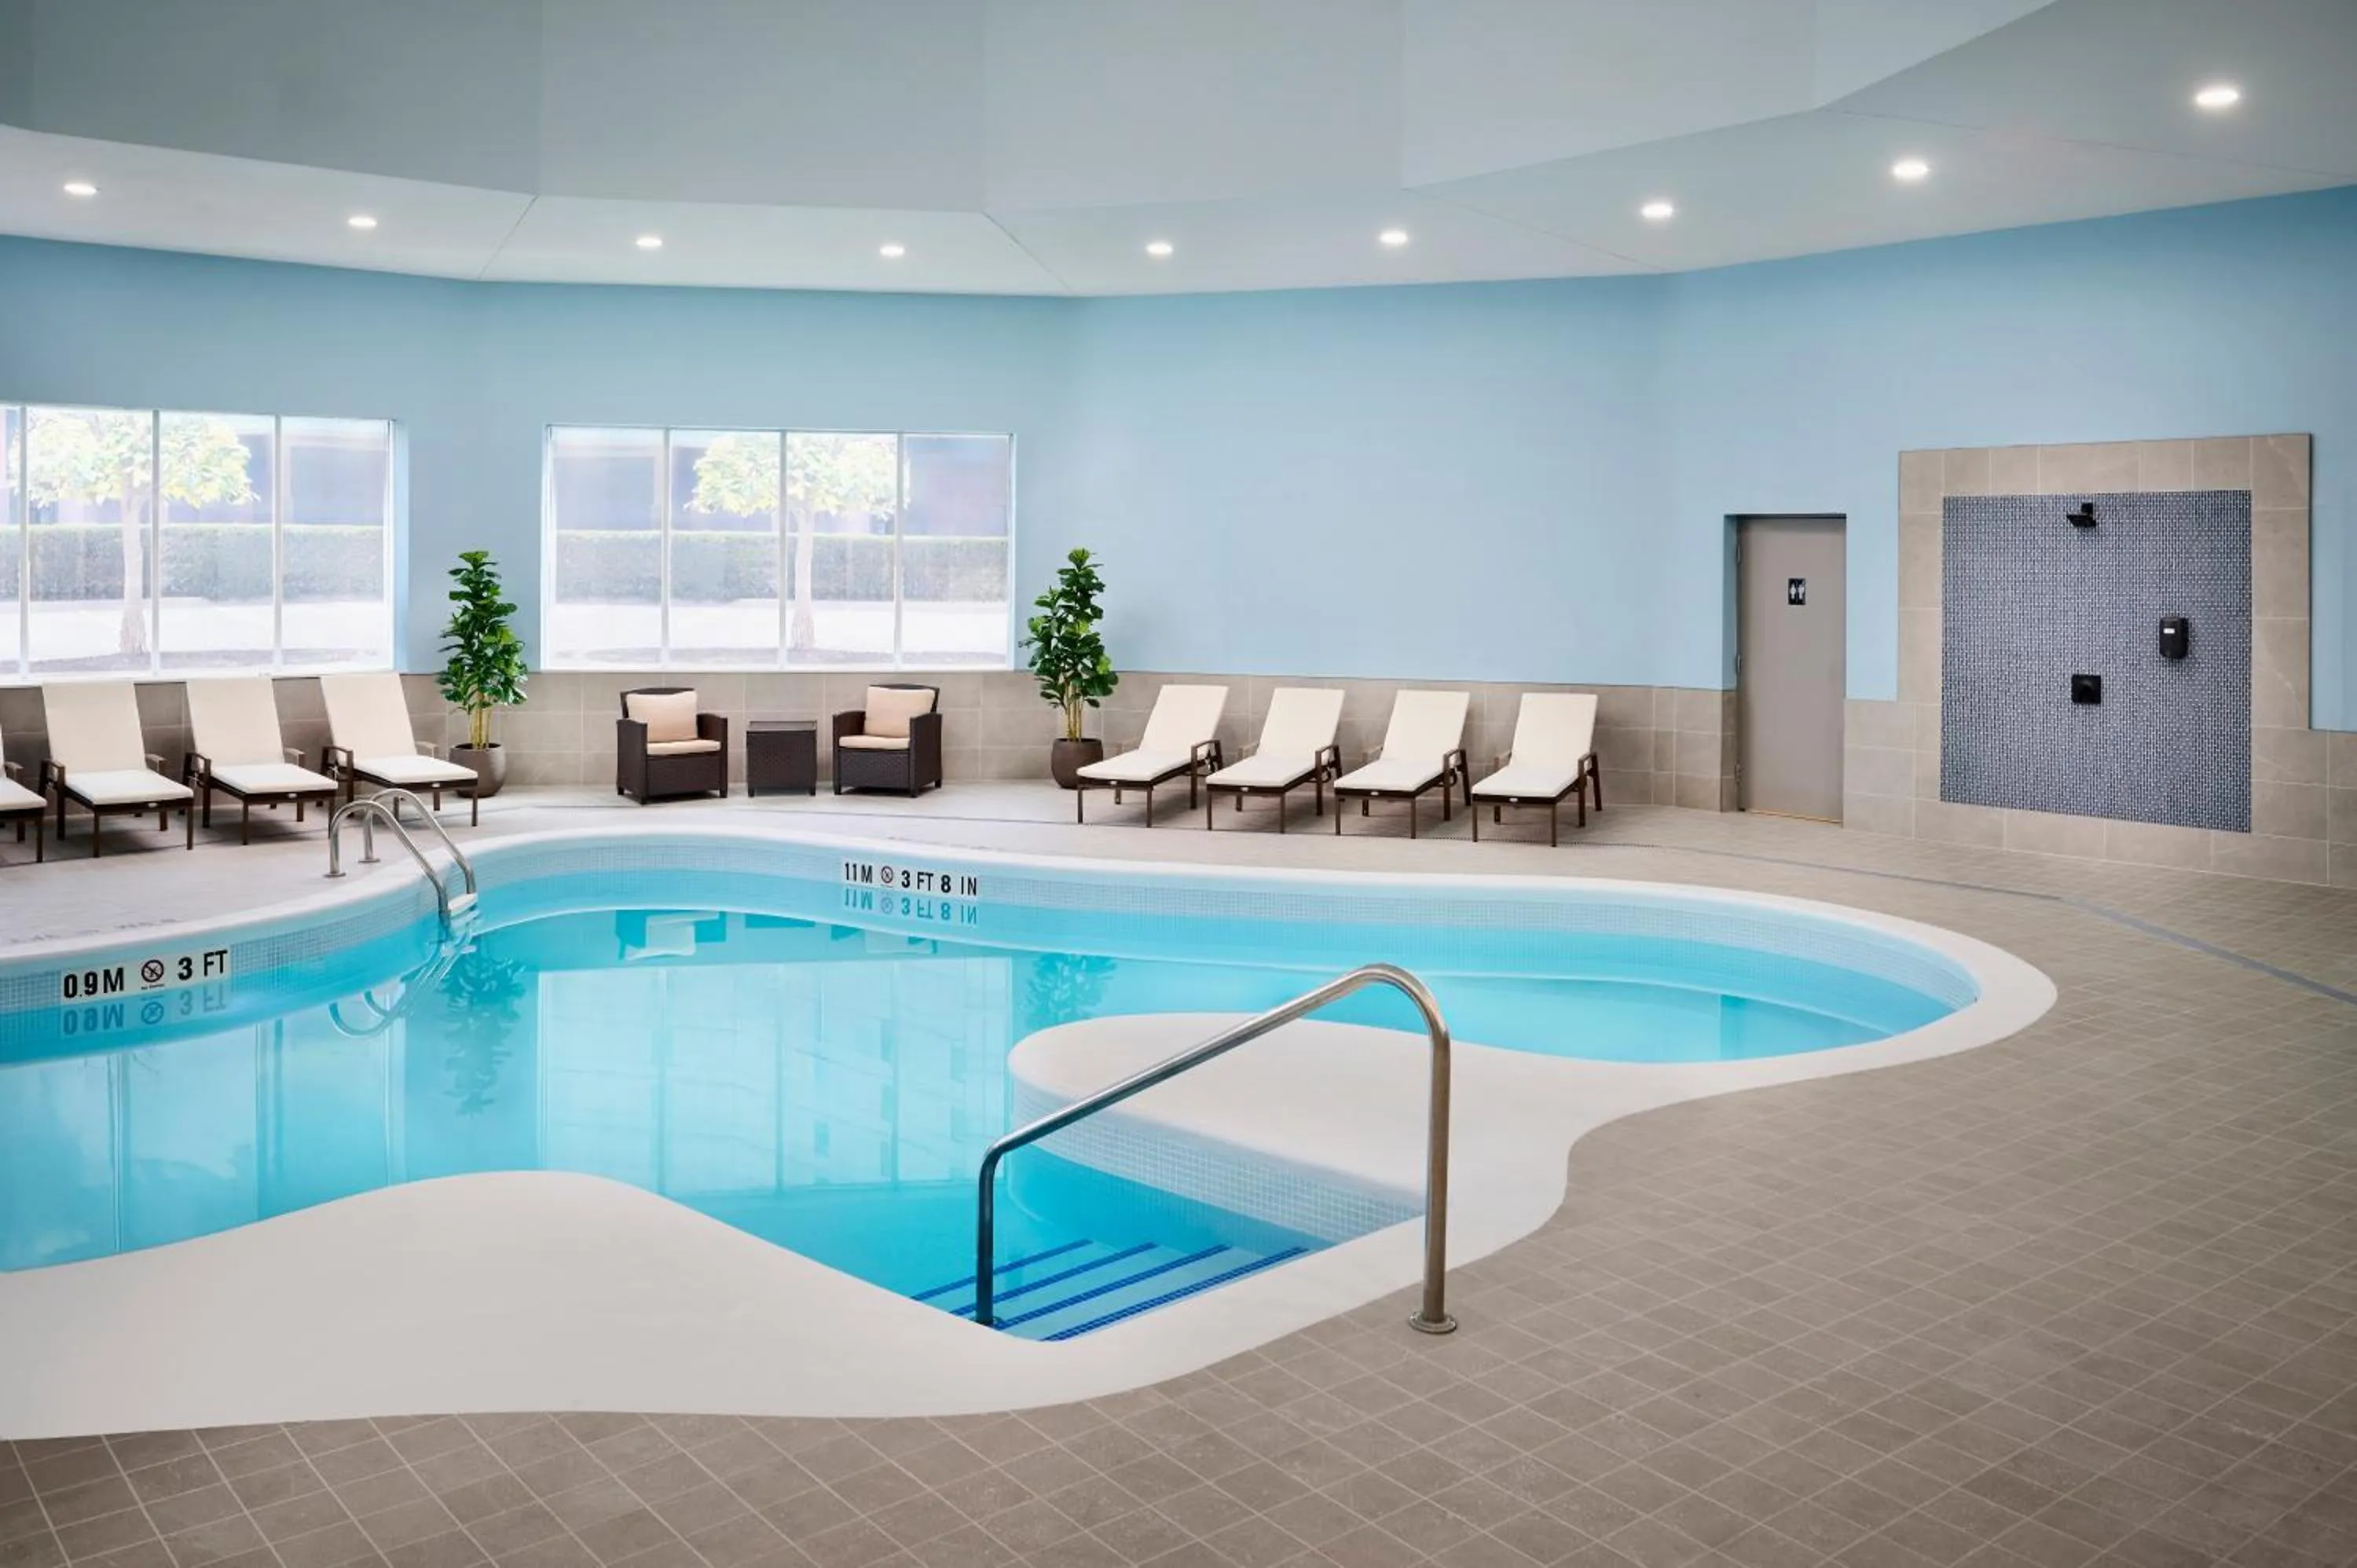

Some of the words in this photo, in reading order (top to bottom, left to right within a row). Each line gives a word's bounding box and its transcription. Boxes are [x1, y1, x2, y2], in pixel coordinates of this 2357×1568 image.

[901, 870, 911, 888] 3
[917, 872, 933, 891] FT
[940, 874, 951, 893] 8
[961, 876, 977, 896] IN
[64, 967, 124, 998] 0.9M
[178, 957, 192, 980] 3
[203, 950, 228, 976] FT
